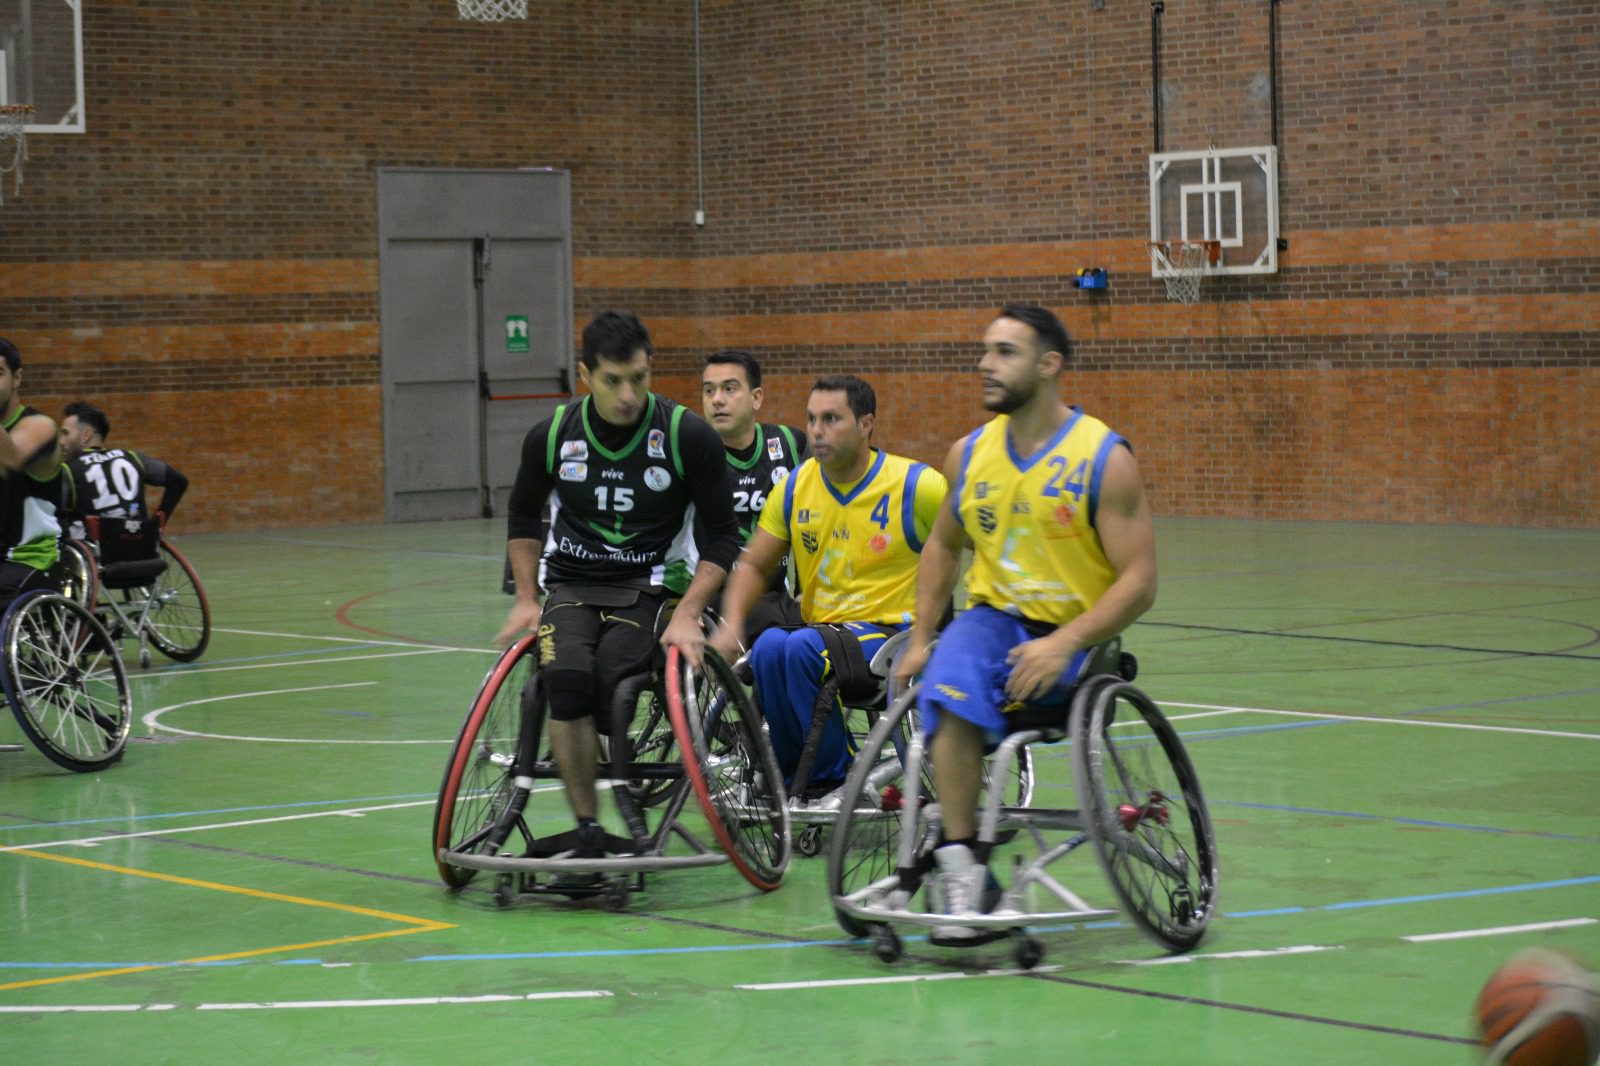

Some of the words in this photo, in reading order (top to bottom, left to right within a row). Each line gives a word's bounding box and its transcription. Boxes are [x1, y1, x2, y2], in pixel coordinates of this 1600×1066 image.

[84, 458, 139, 510] 10
[601, 468, 625, 480] vive
[1041, 455, 1089, 502] 24
[594, 486, 635, 512] 15
[733, 490, 767, 512] 26
[869, 493, 890, 530] 4
